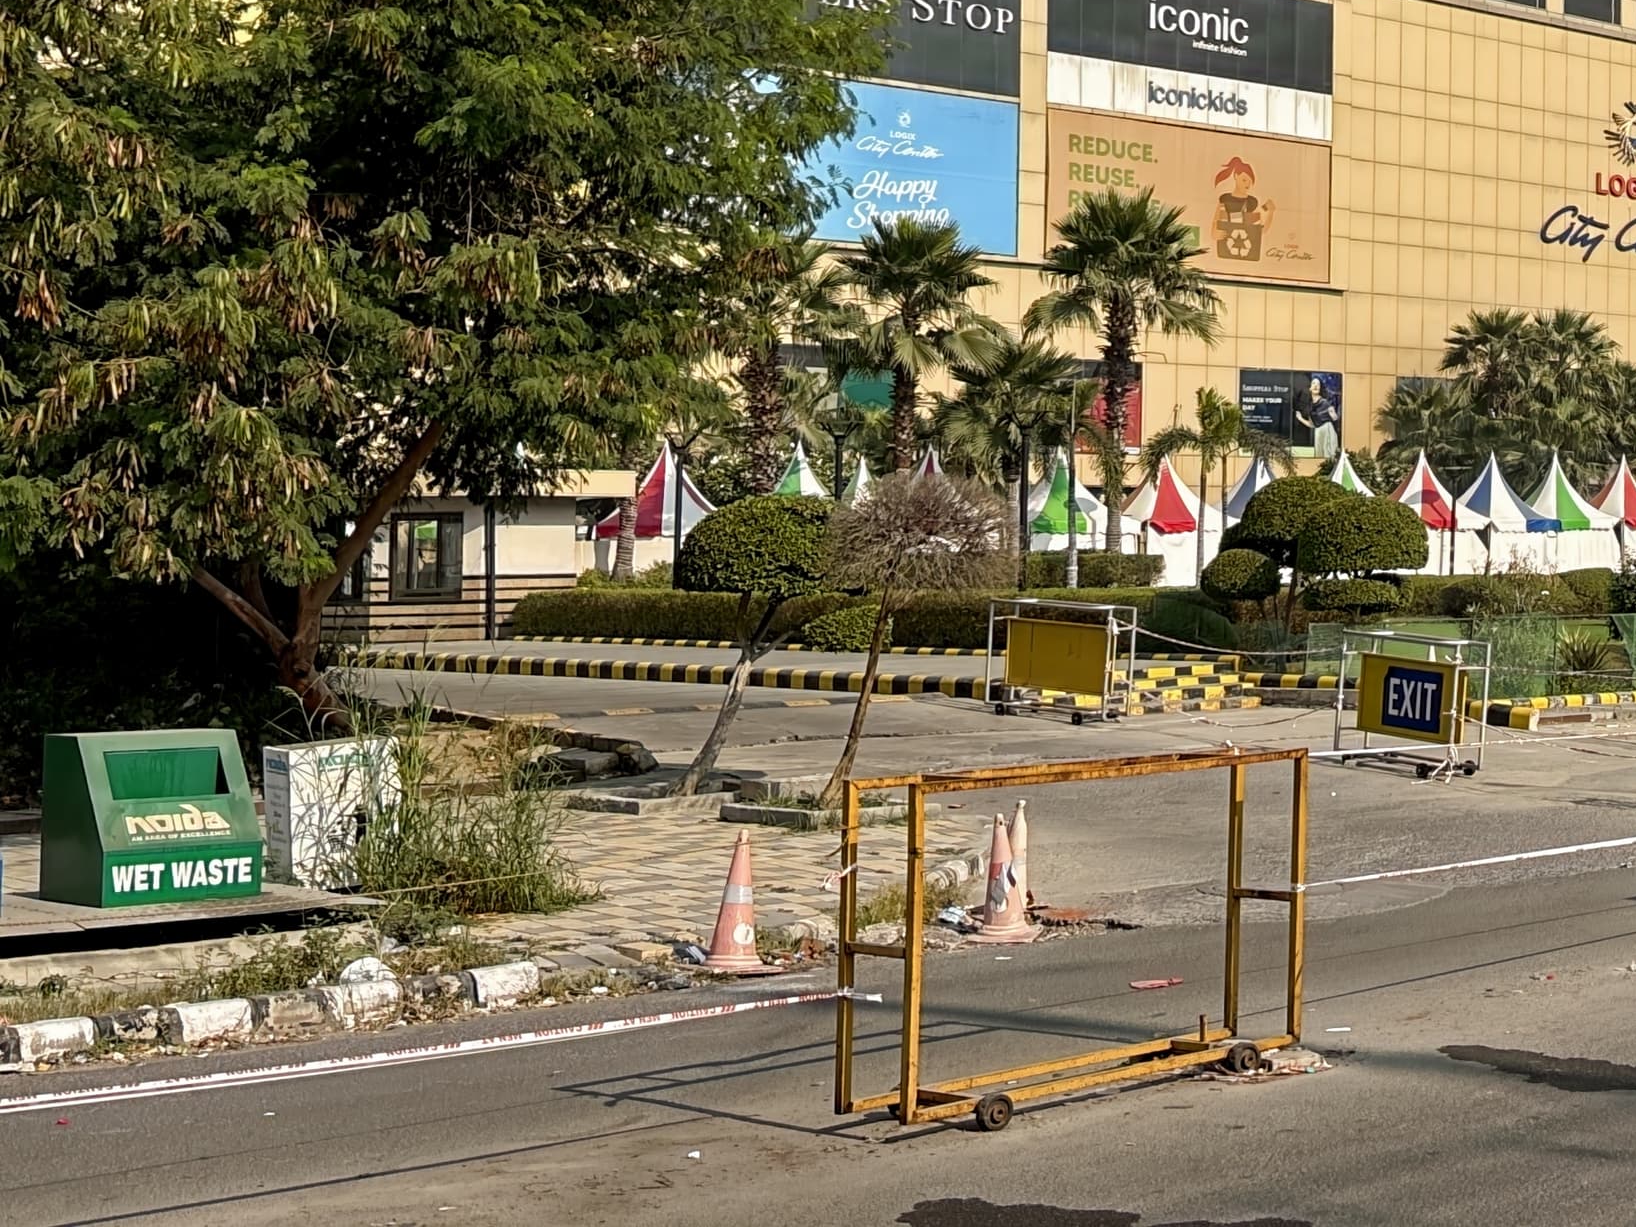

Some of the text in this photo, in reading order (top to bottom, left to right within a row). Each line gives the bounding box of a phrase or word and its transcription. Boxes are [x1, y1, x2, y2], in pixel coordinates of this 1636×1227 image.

[1192, 39, 1248, 57] infinite fashion
[1148, 80, 1248, 116] iconickids
[856, 136, 892, 158] City
[889, 130, 916, 141] LOGIX
[1068, 133, 1158, 163] REDUCE.
[1068, 162, 1140, 188] REUSE.
[852, 170, 938, 210] Happy
[1540, 205, 1610, 262] City
[1388, 677, 1437, 722] EXIT
[125, 804, 231, 835] noida
[180, 829, 231, 839] EXCELLENCE
[112, 856, 253, 893] WET WASTE
[671, 1006, 717, 1020] CAUTION
[534, 1025, 583, 1038] CAUTION
